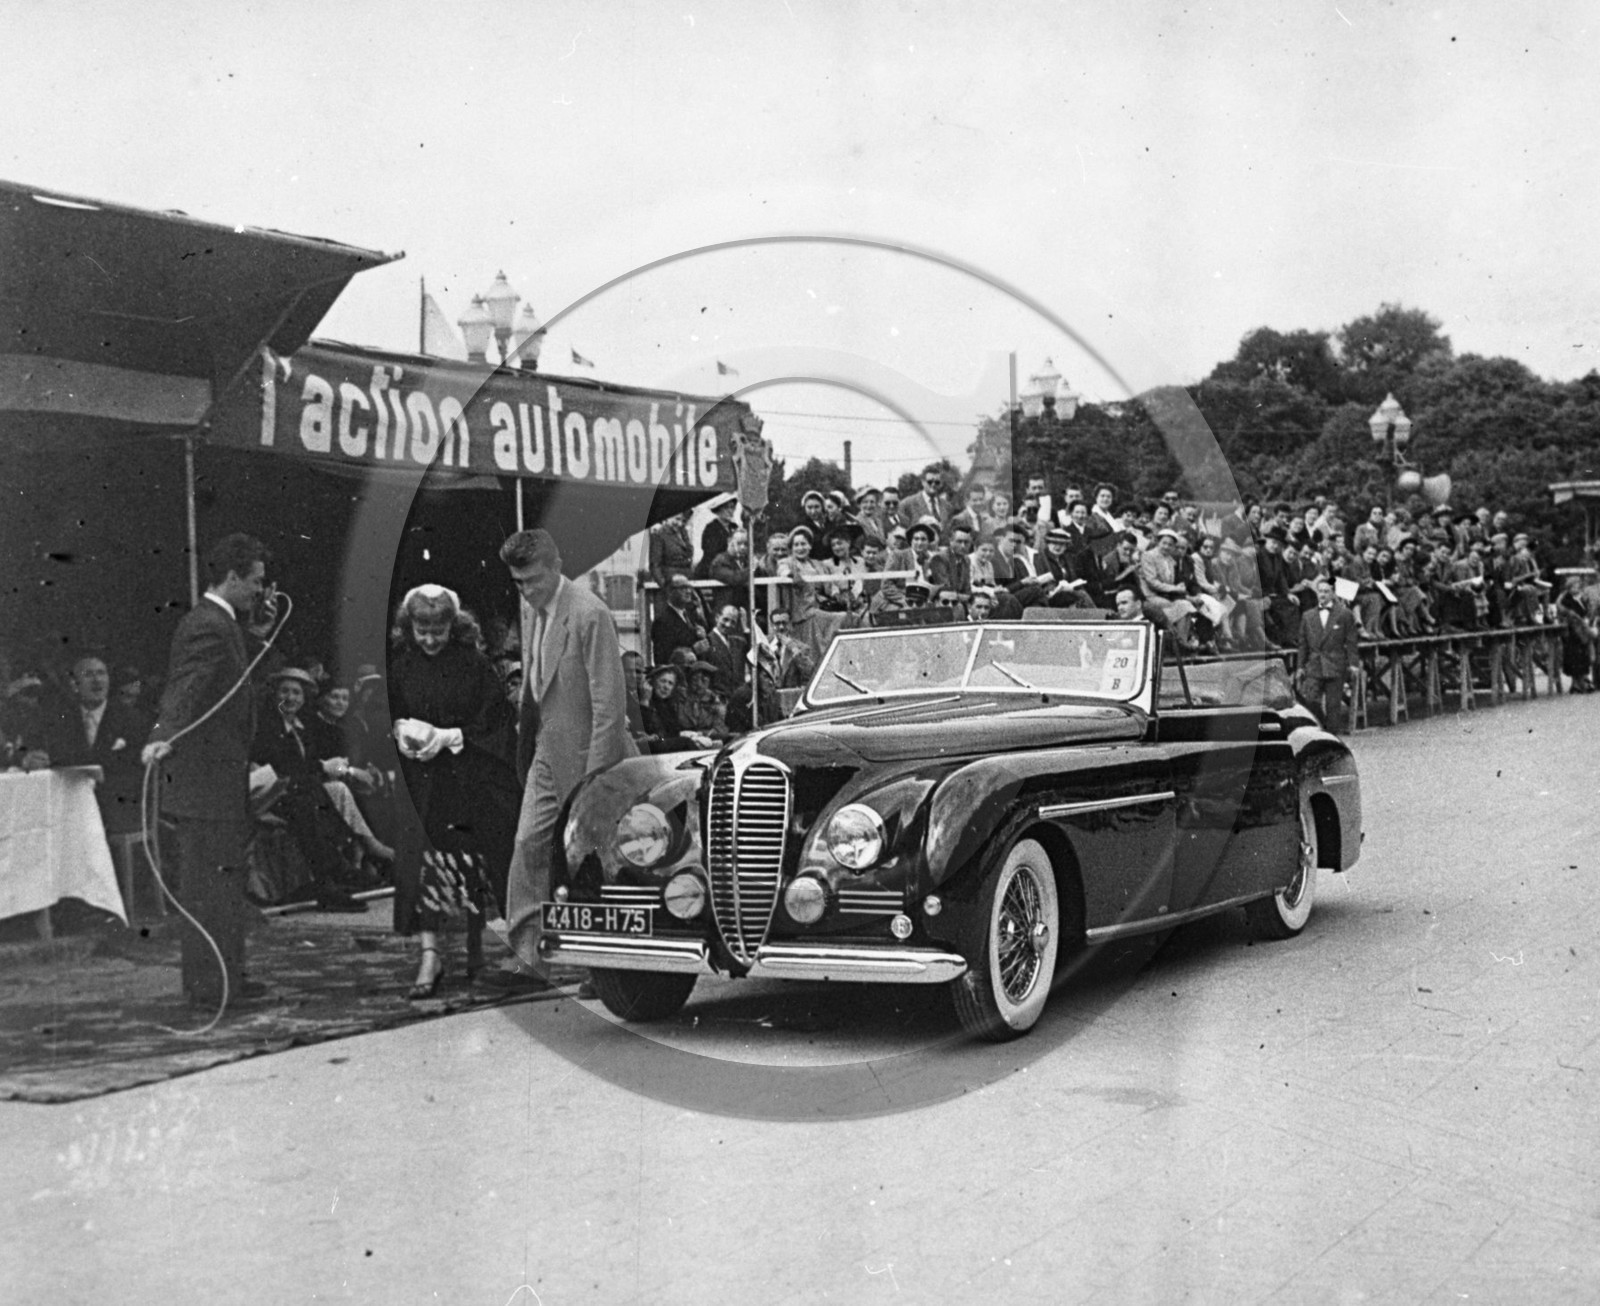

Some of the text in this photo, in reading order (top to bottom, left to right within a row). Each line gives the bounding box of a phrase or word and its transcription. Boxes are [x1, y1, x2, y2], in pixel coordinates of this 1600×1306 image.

[259, 345, 719, 488] l'action automobile
[1112, 656, 1129, 669] 20
[546, 905, 646, 933] 4418-H75
